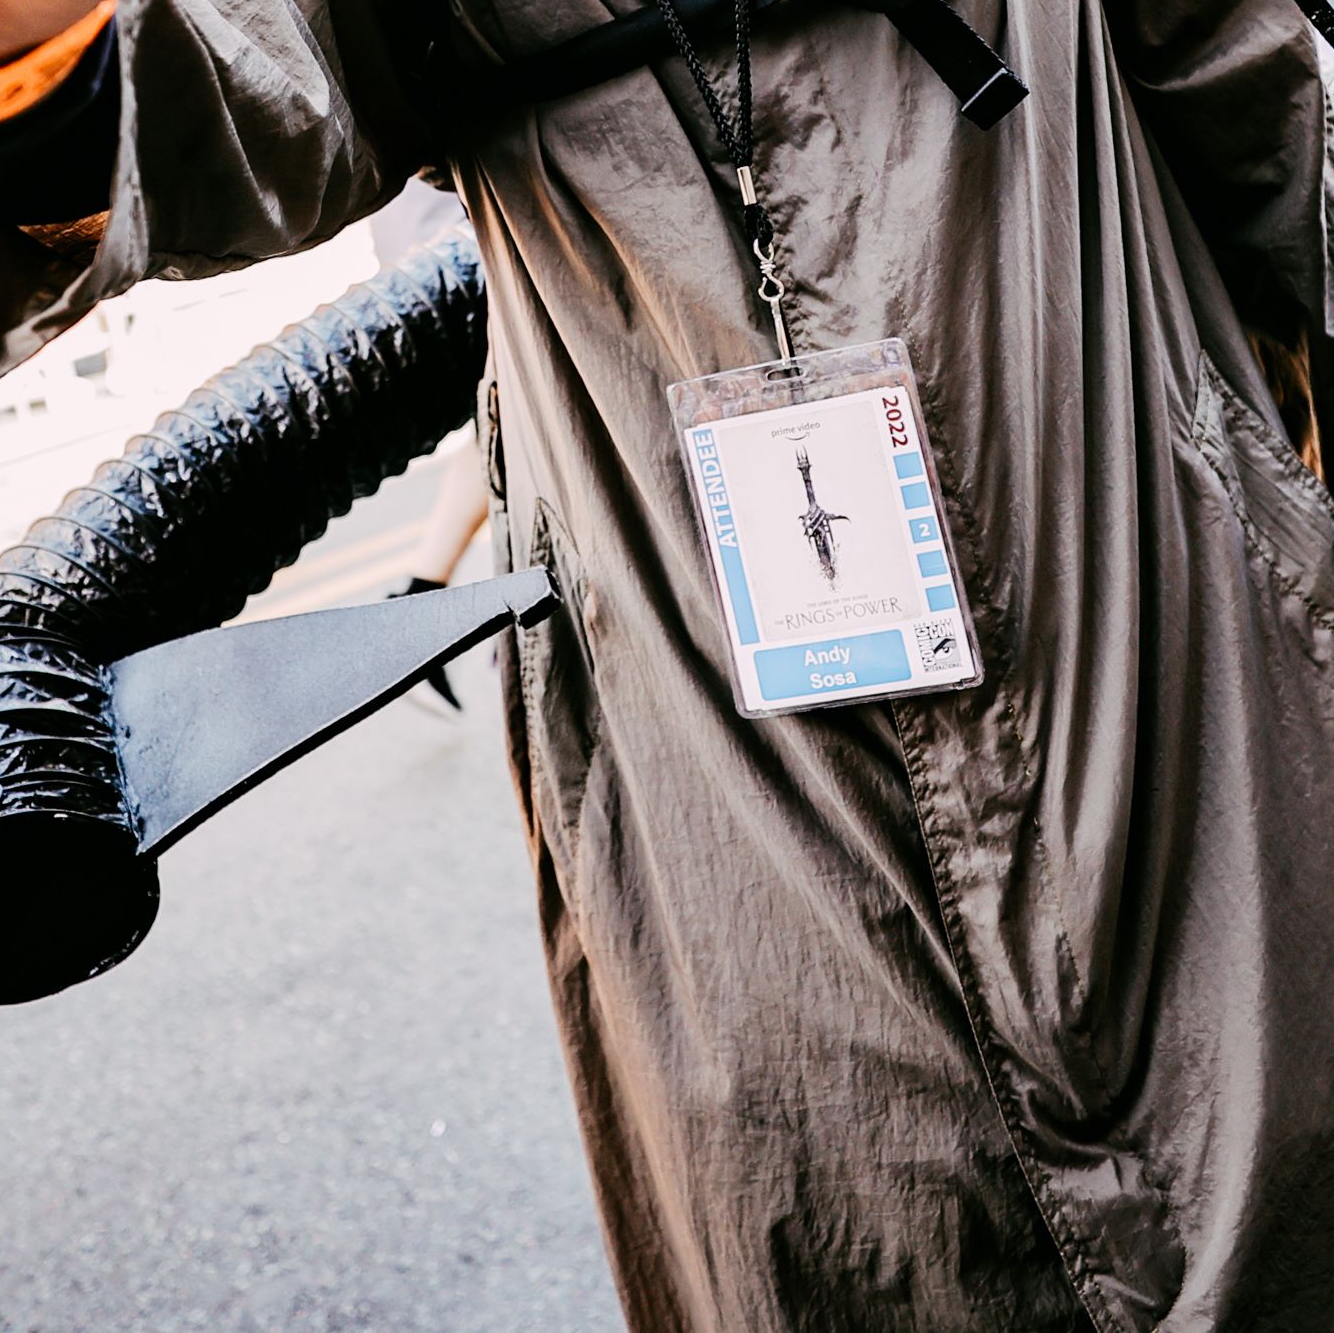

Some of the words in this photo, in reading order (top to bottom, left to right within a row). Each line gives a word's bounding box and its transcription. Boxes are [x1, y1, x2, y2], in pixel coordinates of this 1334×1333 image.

[771, 426, 795, 438] prime
[796, 421, 821, 433] video
[881, 395, 909, 448] 2022
[694, 430, 738, 548] ATTENDEE
[918, 523, 931, 537] 2
[784, 608, 835, 631] RINGS
[843, 596, 903, 619] POWER
[929, 621, 955, 639] CON
[803, 645, 851, 667] Andy
[915, 625, 936, 667] COMIC
[809, 670, 857, 690] Sosa
